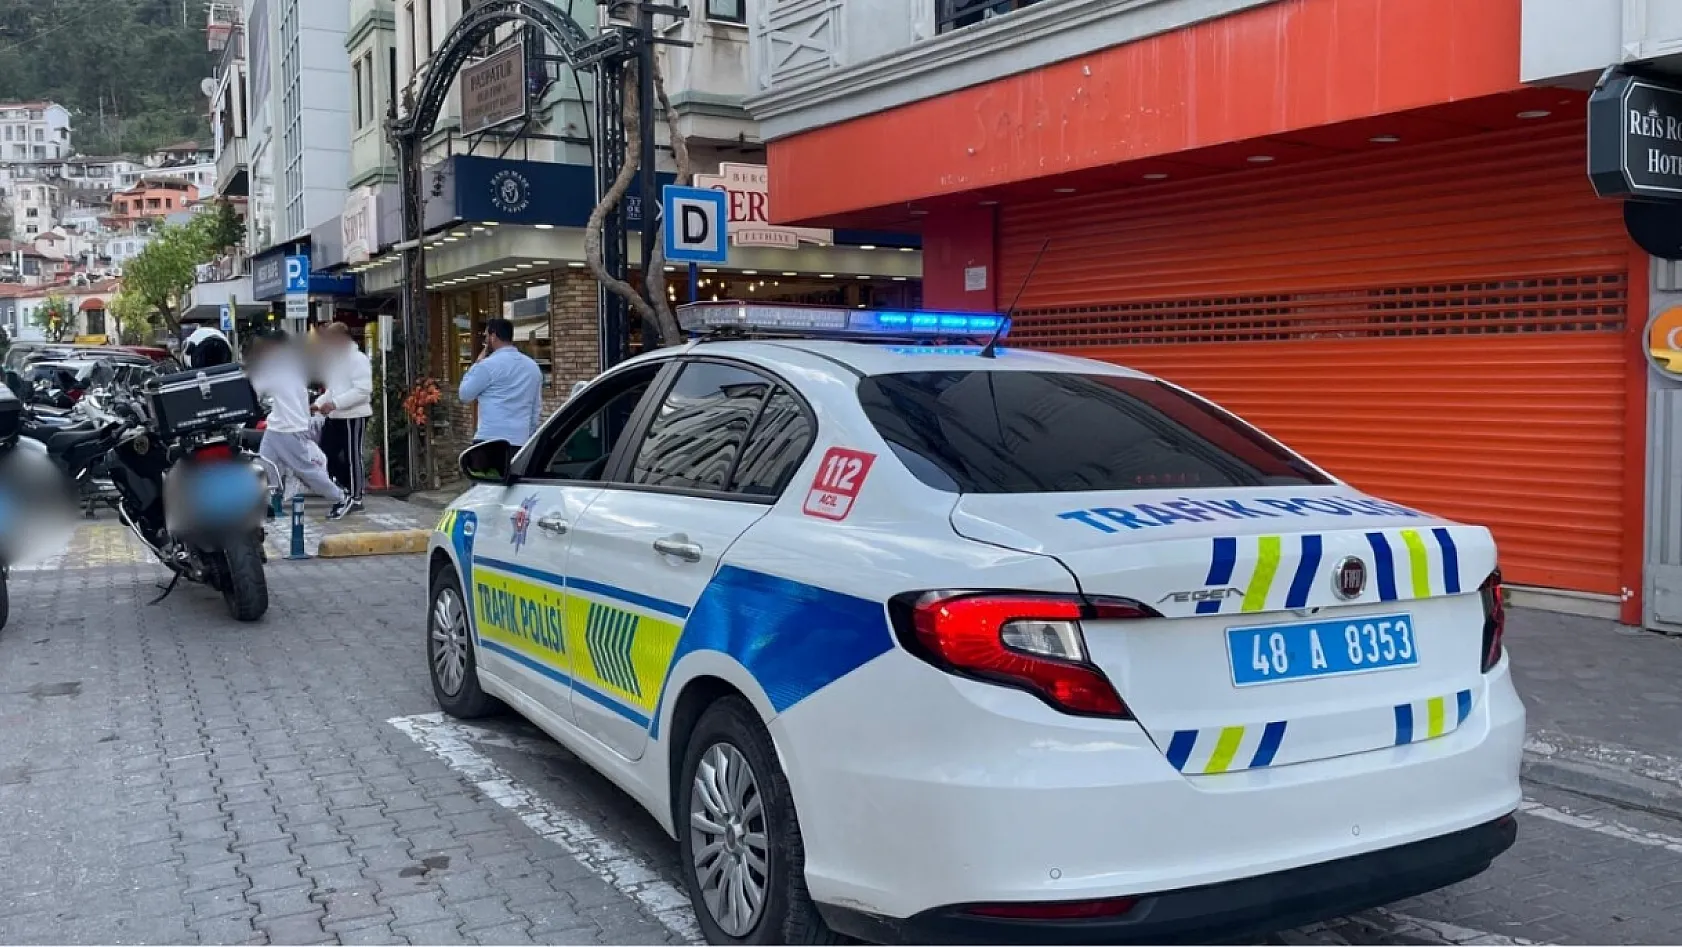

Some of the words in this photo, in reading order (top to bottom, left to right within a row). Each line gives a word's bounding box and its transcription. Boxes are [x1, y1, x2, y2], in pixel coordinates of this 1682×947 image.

[681, 203, 709, 244] D
[286, 259, 301, 288] P
[822, 455, 863, 490] 112
[1056, 497, 1263, 534] TRAFİK
[1344, 569, 1361, 589] FIAT
[477, 581, 521, 636] TRAFİK
[520, 593, 566, 655] POLİSİ
[1252, 632, 1288, 676] 48
[1309, 628, 1328, 669] A
[1344, 620, 1412, 665] 8353
